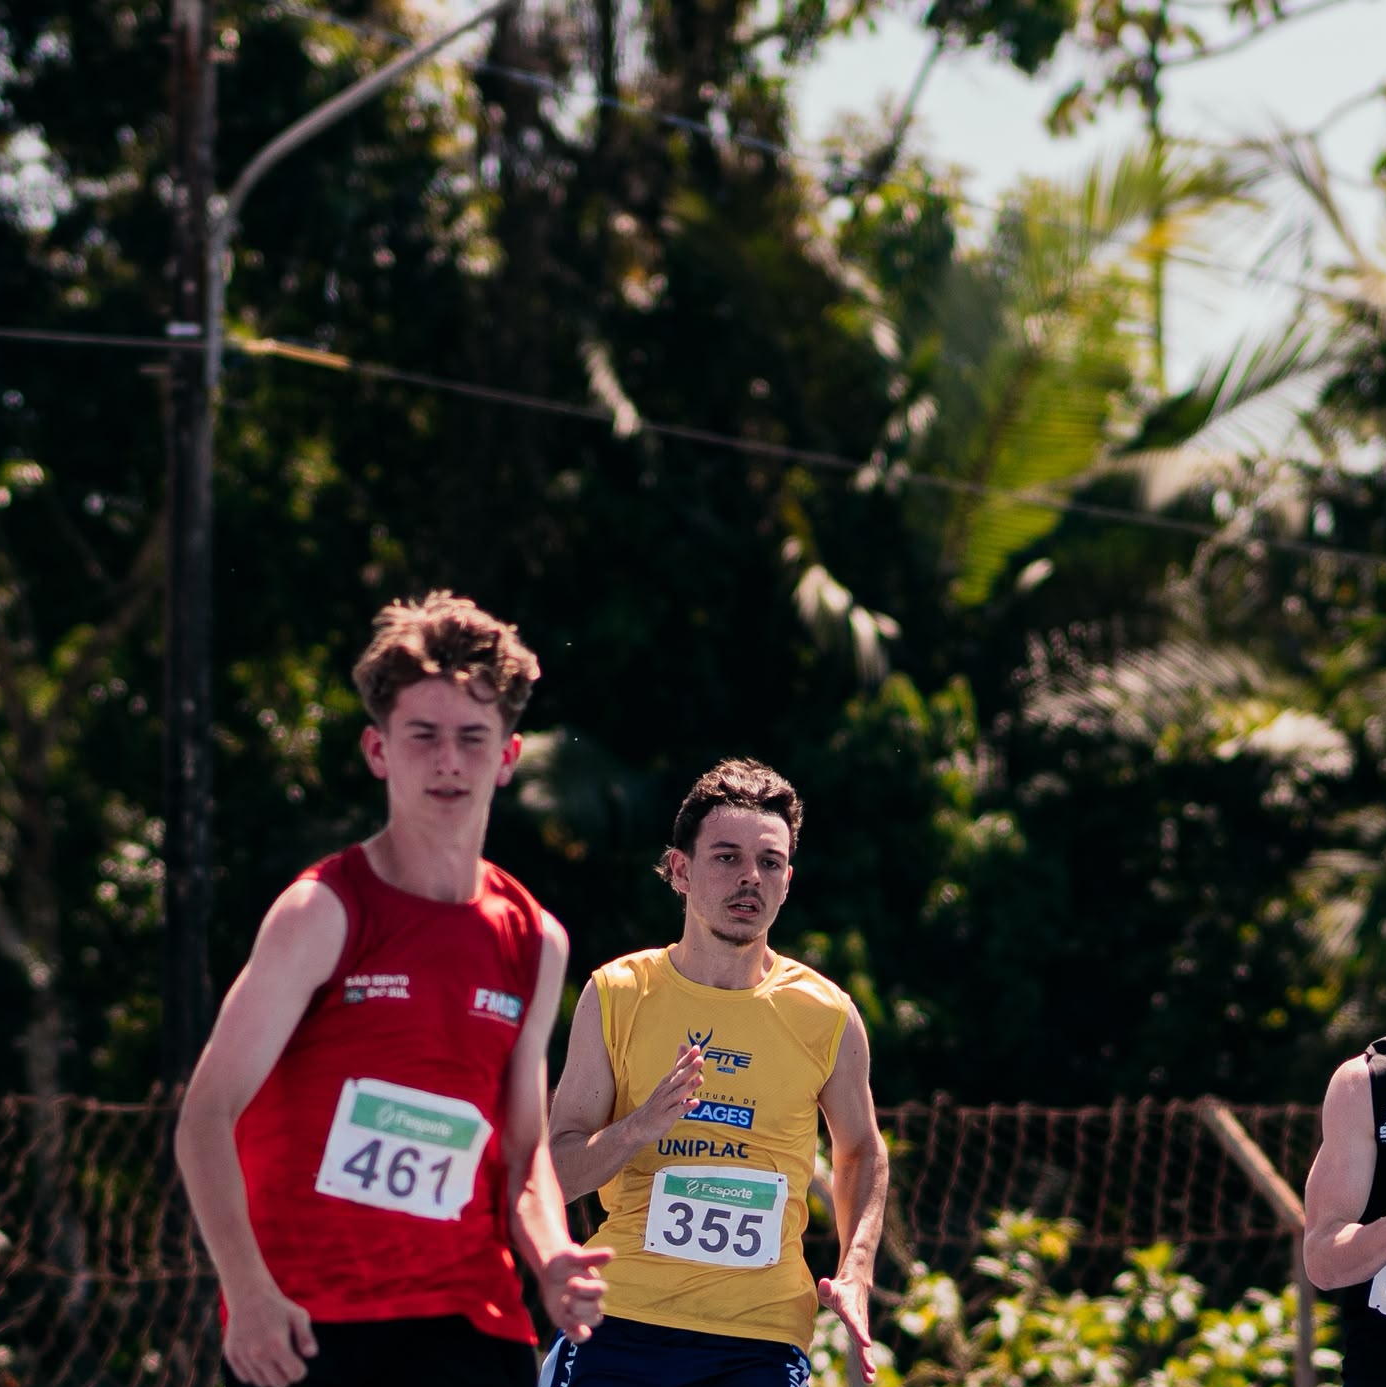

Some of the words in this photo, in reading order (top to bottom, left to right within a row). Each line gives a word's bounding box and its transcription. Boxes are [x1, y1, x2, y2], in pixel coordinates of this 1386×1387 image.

[388, 987, 410, 999] SUL
[691, 1090, 734, 1103] EITURA
[743, 1098, 757, 1106] DE
[688, 1103, 750, 1126] LAGES
[658, 1139, 749, 1159] UNIPLAC
[342, 1139, 453, 1206] 461
[701, 1183, 753, 1199] Fesporte
[662, 1202, 764, 1257] 355
